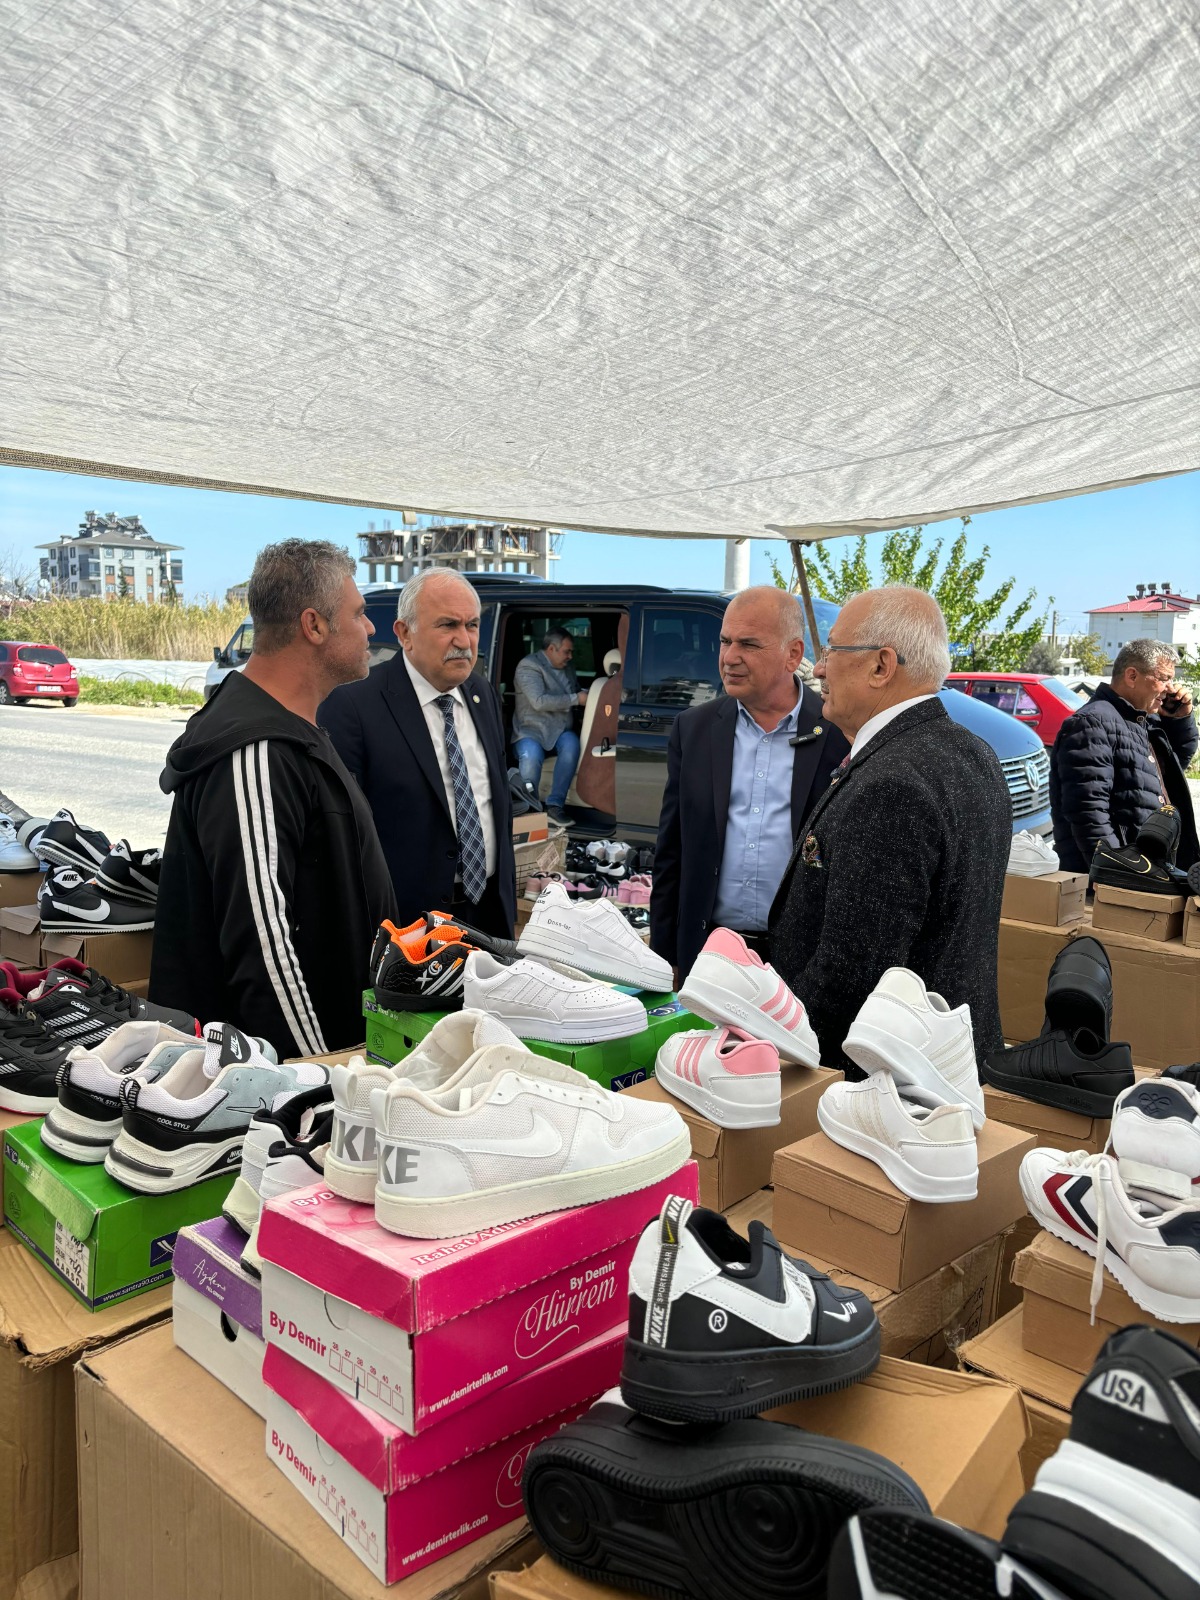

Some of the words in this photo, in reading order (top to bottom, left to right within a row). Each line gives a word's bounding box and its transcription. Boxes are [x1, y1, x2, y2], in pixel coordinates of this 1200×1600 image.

[61, 873, 79, 882] NIKE
[70, 1000, 91, 1013] adidas
[724, 1002, 750, 1021] adidas
[156, 1117, 173, 1127] COOL
[173, 1121, 191, 1131] STYLE
[411, 1237, 479, 1265] Rahat
[55, 1257, 86, 1293] GARSON
[102, 1273, 165, 1303] www.santra90.com
[569, 1276, 584, 1291] By
[585, 1259, 617, 1283] Demir
[656, 1251, 673, 1303] SPORTSWEAR
[517, 1276, 619, 1347] Hürrem
[650, 1302, 665, 1345] NIKE
[269, 1310, 286, 1336] By
[288, 1320, 327, 1358] Demir
[344, 1349, 352, 1359] 37
[369, 1365, 377, 1375] 39
[429, 1364, 509, 1414] www.demirterlik.com
[1101, 1371, 1146, 1413] USA
[271, 1429, 285, 1456] By
[285, 1443, 317, 1487] Demir
[401, 1514, 489, 1566] www.demirterlik.com
